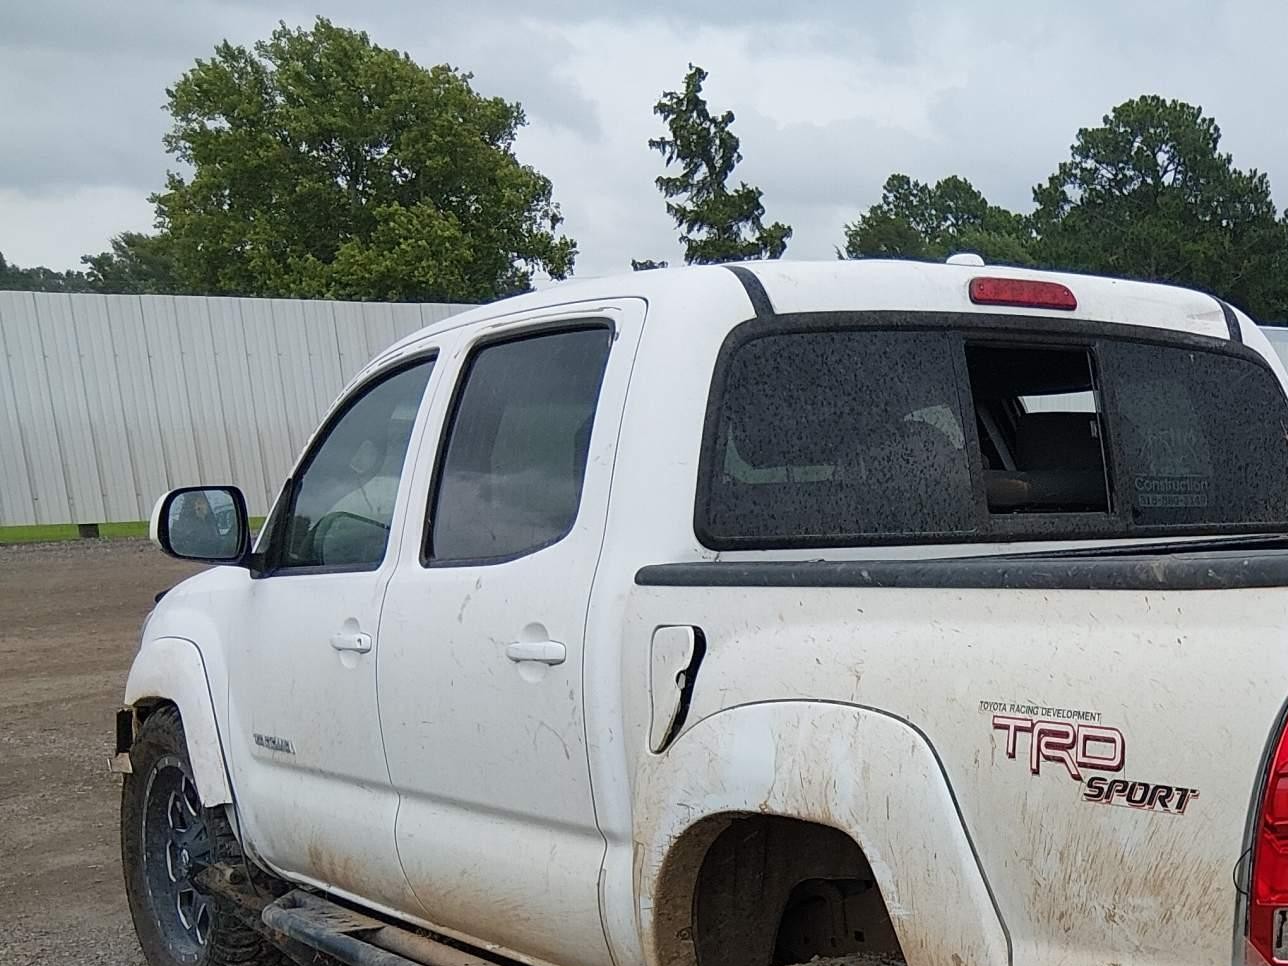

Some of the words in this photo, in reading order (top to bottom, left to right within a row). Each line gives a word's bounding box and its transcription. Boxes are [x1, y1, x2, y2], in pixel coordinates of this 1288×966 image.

[979, 700, 1007, 713] TOYOTA
[1009, 703, 1039, 716] RACING
[1041, 707, 1102, 722] DEVELOPMENT
[992, 714, 1126, 782] TRD
[1083, 776, 1199, 815] SPORT
